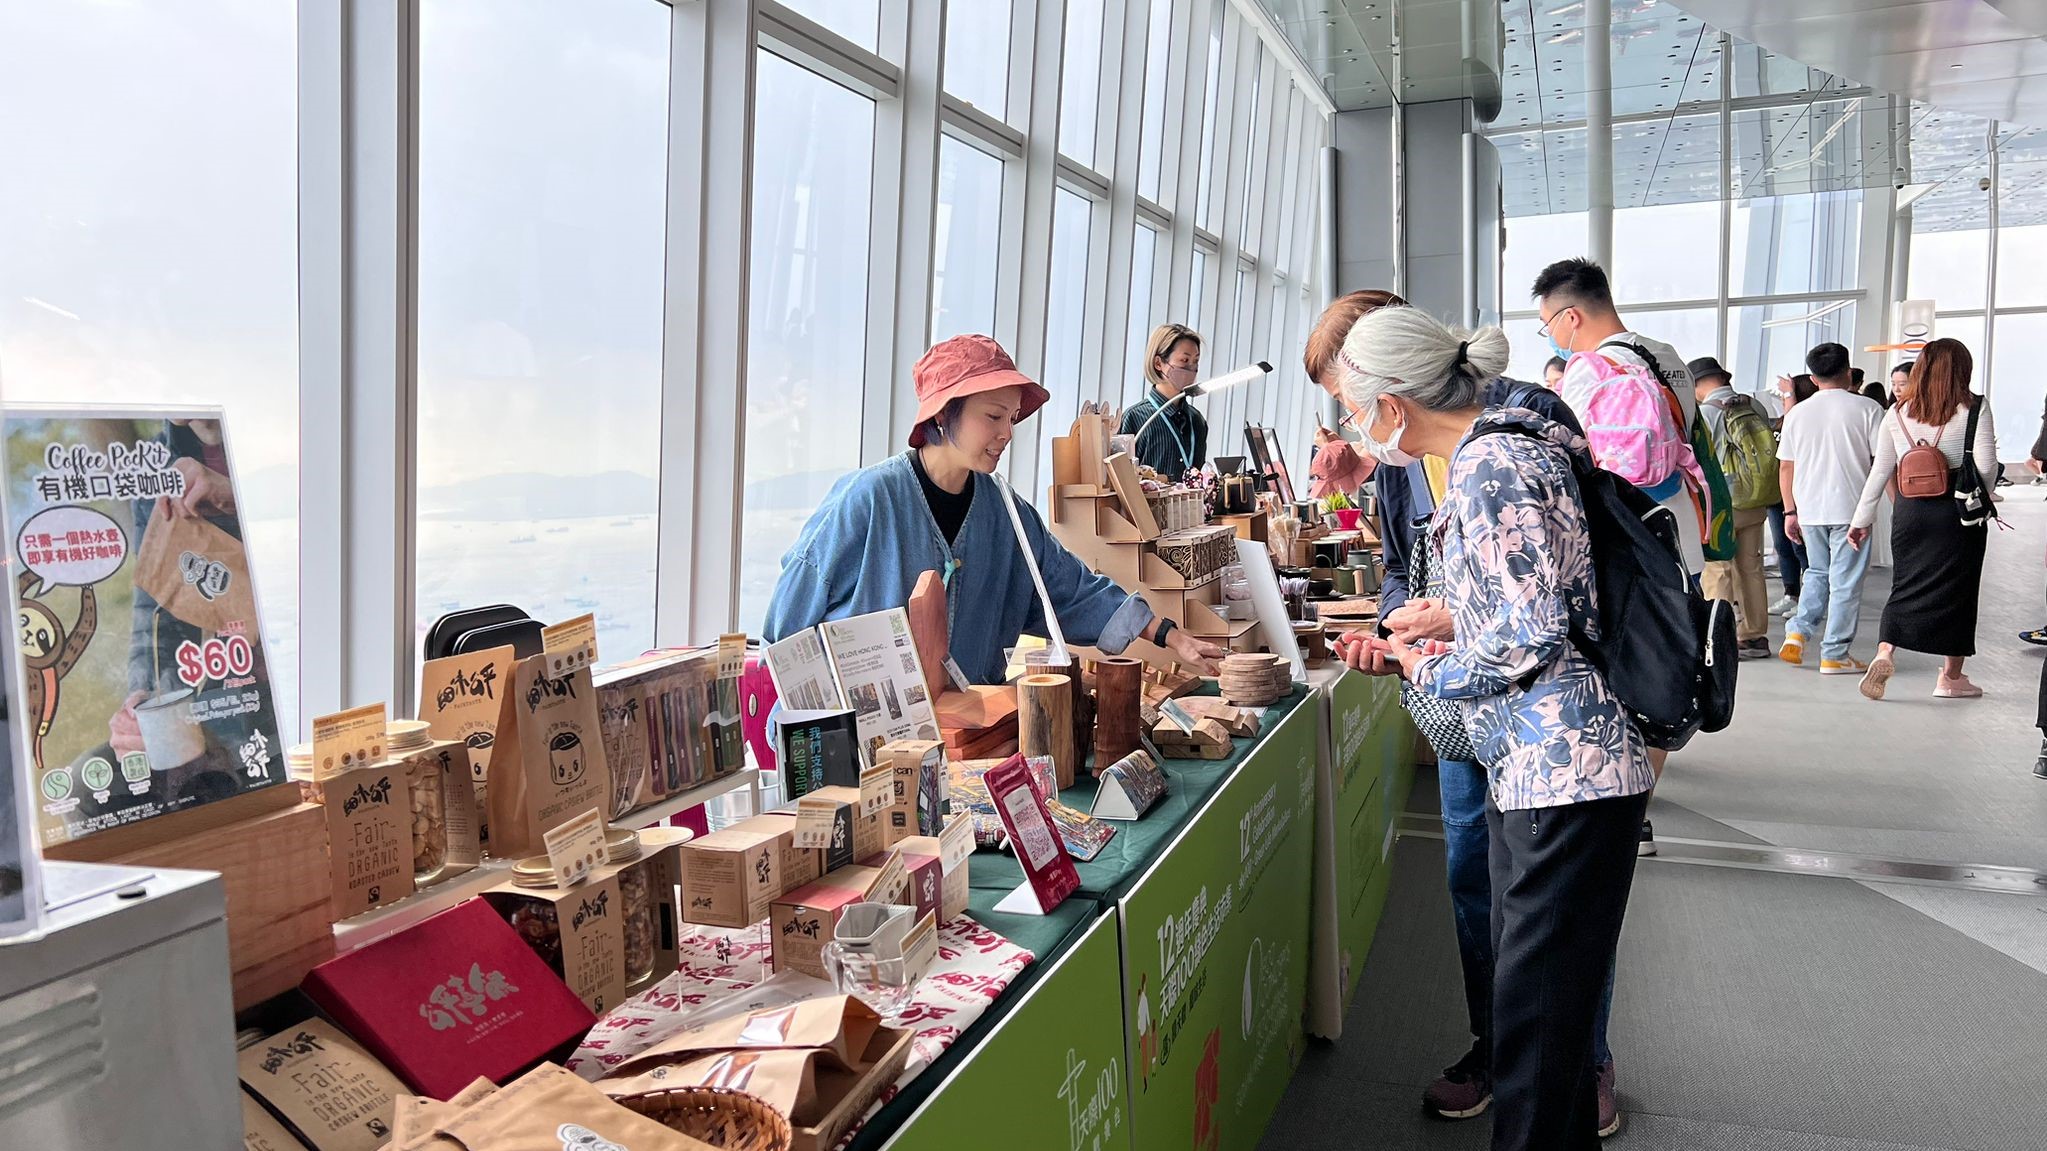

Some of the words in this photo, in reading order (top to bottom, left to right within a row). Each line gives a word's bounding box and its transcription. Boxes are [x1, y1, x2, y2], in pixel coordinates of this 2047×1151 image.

[48, 445, 104, 475] Coffee
[36, 471, 183, 502] 有機口袋咖啡
[24, 528, 119, 549] 只需一個熱水壺
[27, 544, 122, 565] 即享有機好咖啡
[177, 635, 252, 685] $60
[846, 649, 858, 658] LOVE
[858, 646, 871, 655] HONG
[792, 728, 805, 747] WE
[793, 748, 808, 797] SUPPORT
[348, 847, 399, 878] ORGANIC
[578, 958, 613, 990] ORGANIC
[313, 1080, 381, 1122] ORGANIC
